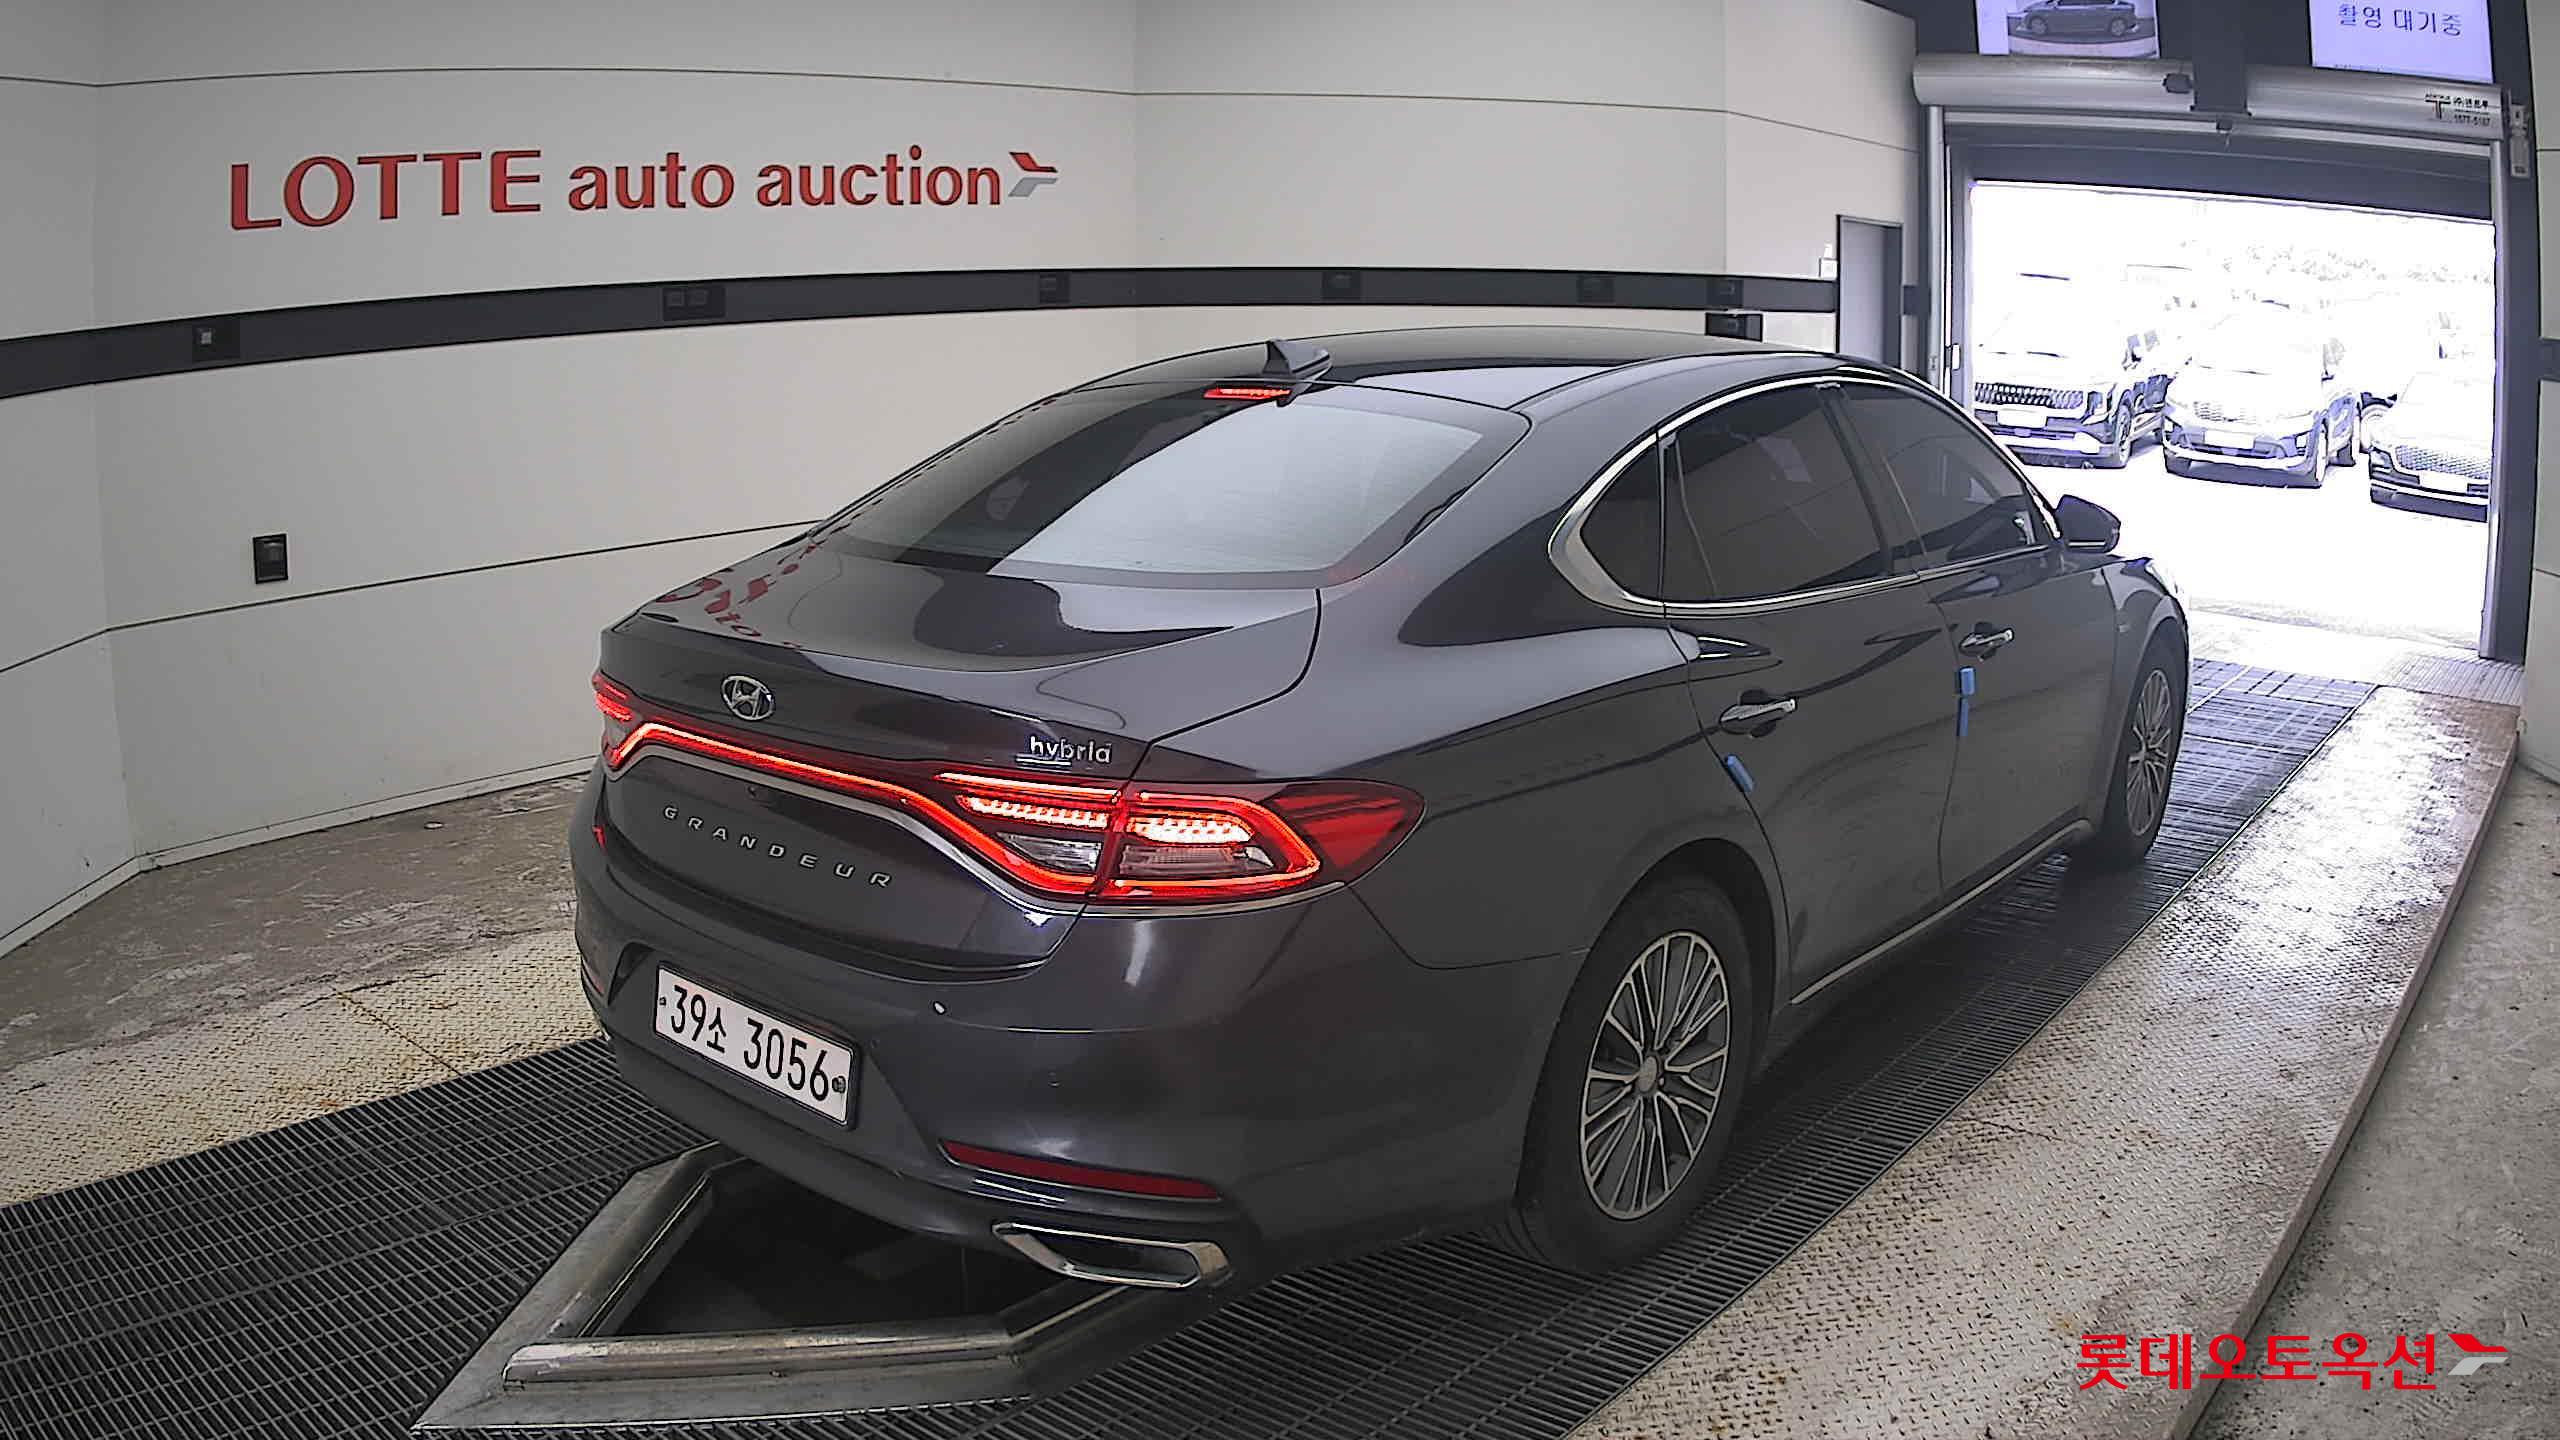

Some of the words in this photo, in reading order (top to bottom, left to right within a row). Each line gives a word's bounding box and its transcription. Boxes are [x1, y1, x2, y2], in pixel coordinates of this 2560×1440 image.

[2338, 4, 2383, 29] 촬영
[2392, 8, 2462, 36] 대기중
[230, 149, 542, 231] LOTTE
[567, 151, 736, 210] auto
[756, 145, 1003, 207] auction
[663, 805, 892, 888] GRANDEUR
[670, 984, 727, 1054] 39소
[743, 1016, 830, 1102] 3056
